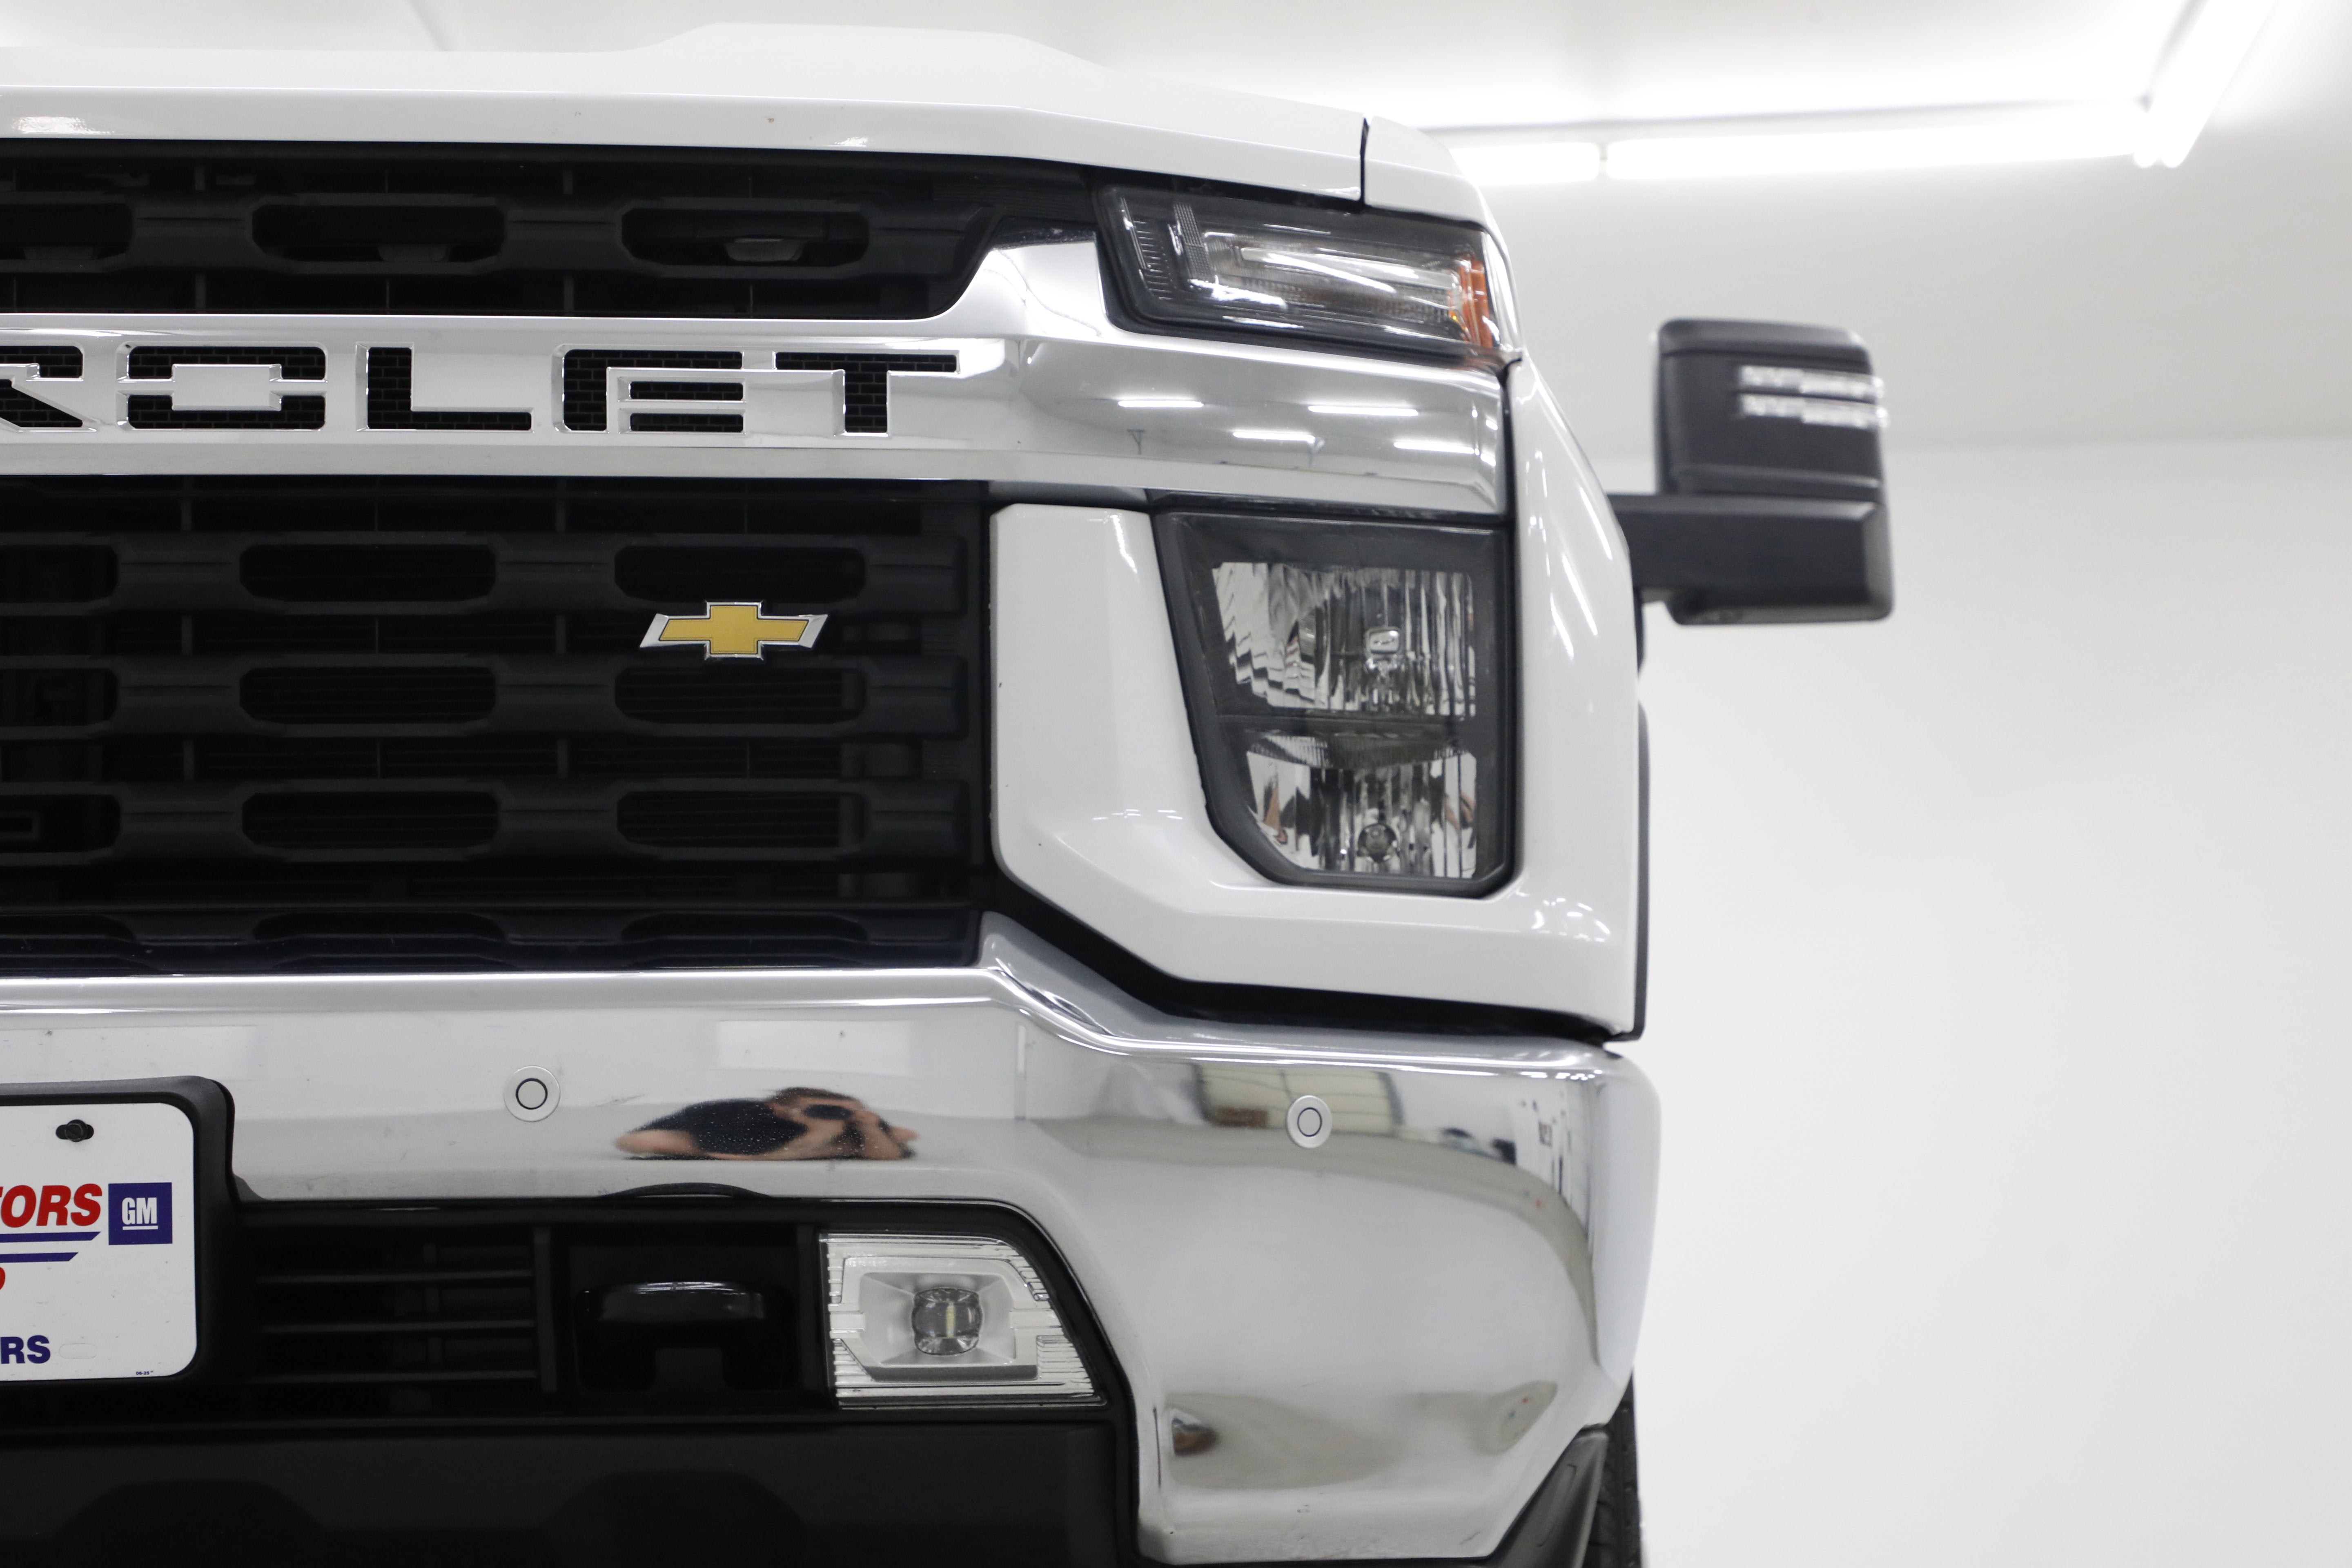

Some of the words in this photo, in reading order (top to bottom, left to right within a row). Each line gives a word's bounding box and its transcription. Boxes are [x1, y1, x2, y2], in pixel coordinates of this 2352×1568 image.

[0, 1183, 102, 1228] ORS
[122, 1197, 157, 1225] GM
[0, 1334, 51, 1364] RS
